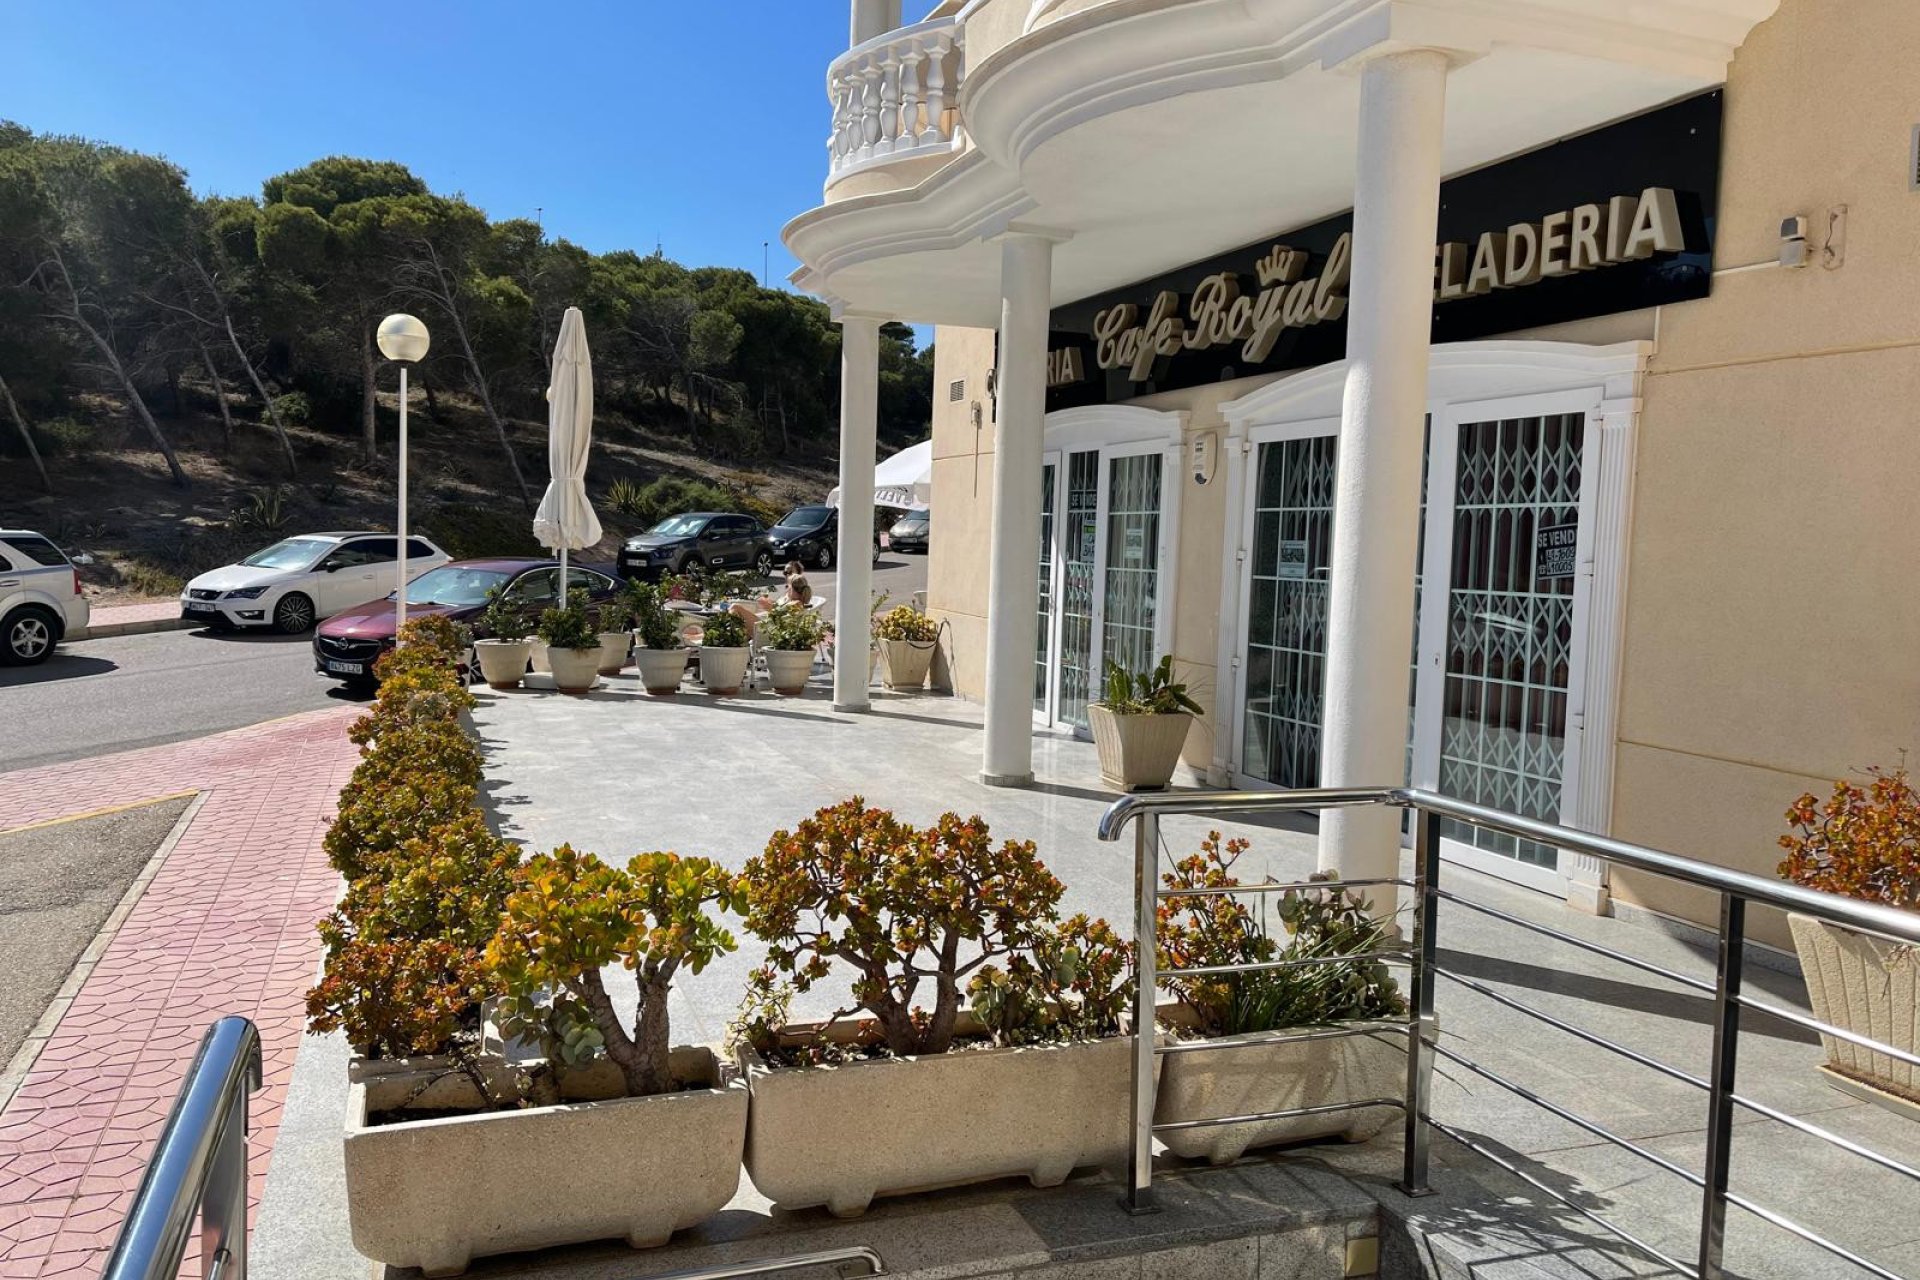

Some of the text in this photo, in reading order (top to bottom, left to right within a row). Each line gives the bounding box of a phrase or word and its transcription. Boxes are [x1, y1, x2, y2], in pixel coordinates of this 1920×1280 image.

[1094, 290, 1184, 381] Cafe
[1182, 232, 1352, 363] Royal
[1434, 187, 1685, 303] LADERIA
[1538, 532, 1548, 548] SE
